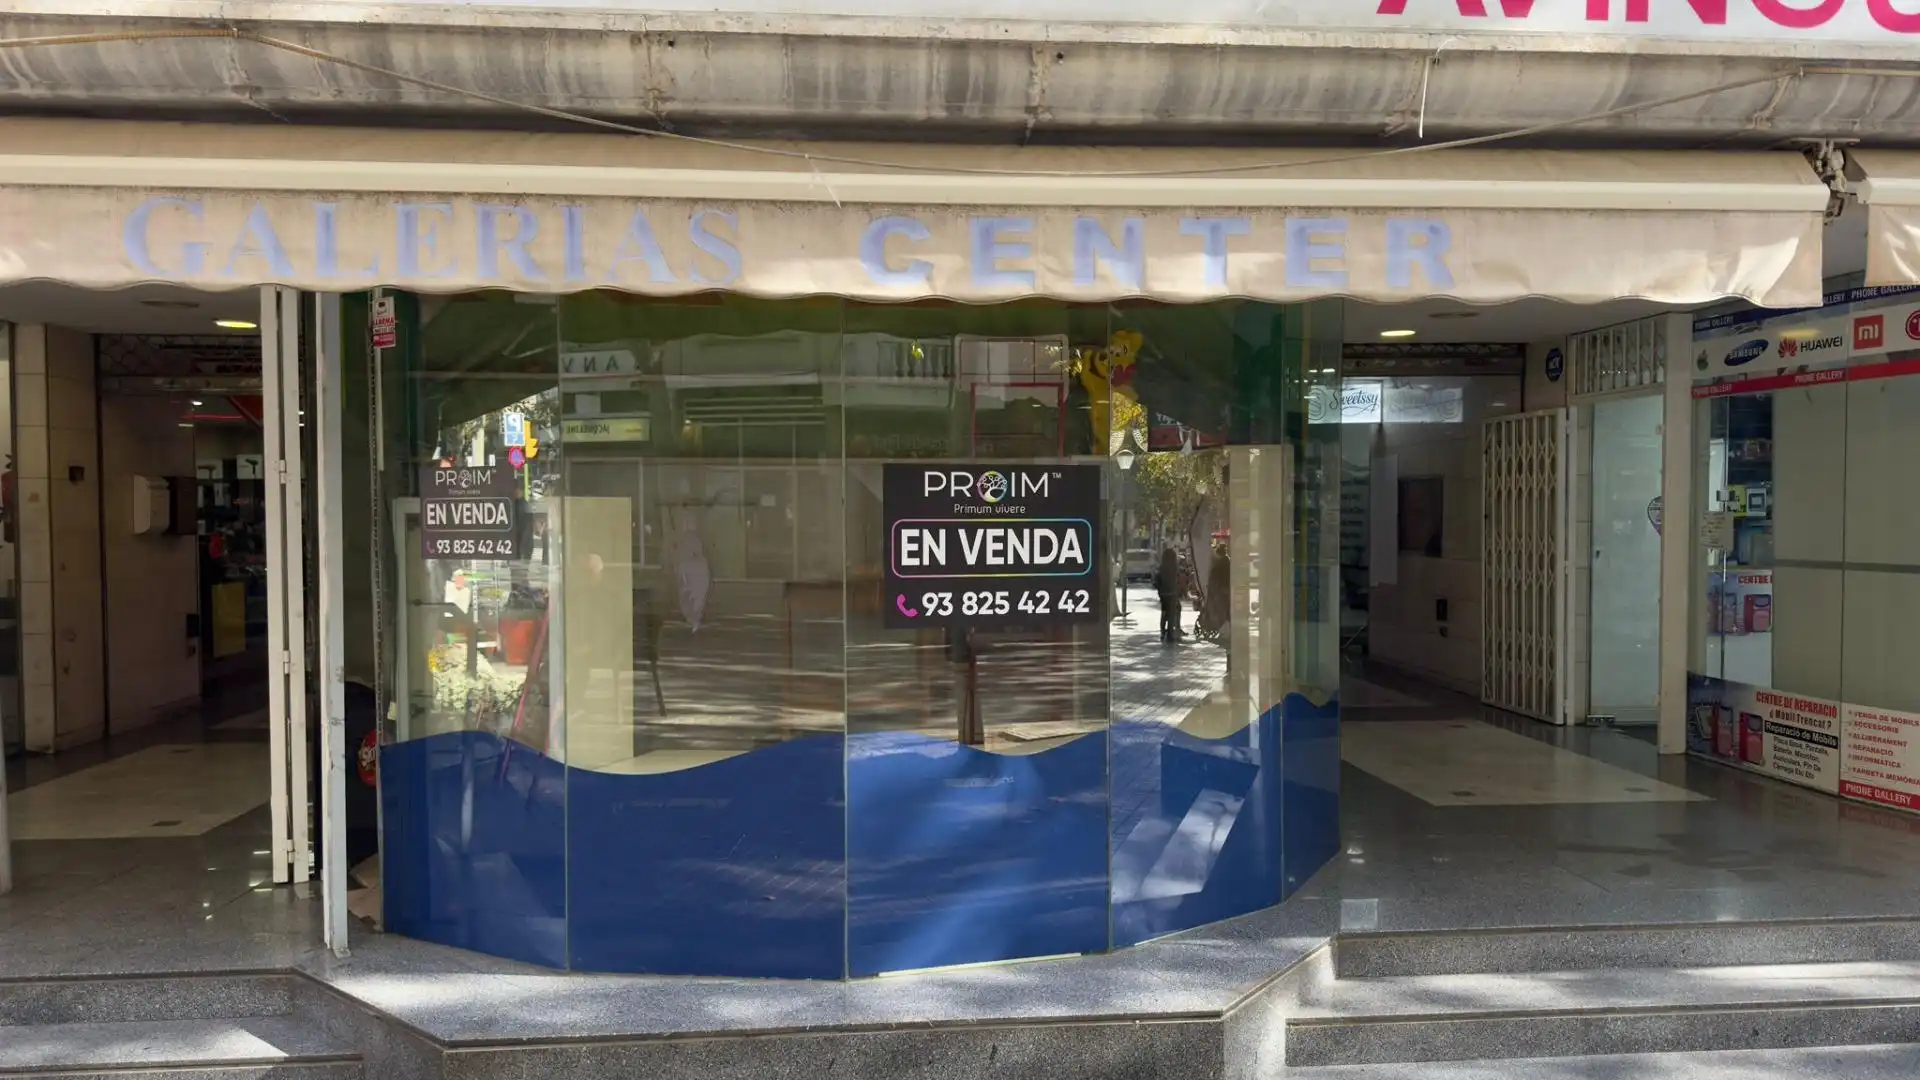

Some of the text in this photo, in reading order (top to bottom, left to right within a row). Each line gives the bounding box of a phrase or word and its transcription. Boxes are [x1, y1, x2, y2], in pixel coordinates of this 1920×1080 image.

[122, 195, 1456, 291] GALERIAS CENTER
[1850, 288, 1877, 299] PHONE
[1800, 337, 1843, 353] HUAWEI
[1816, 370, 1844, 381] GALLERY
[1329, 389, 1379, 413] Sweetssy
[924, 470, 1048, 502] PROIM
[426, 502, 508, 525] EN VENDA
[954, 503, 1026, 514] Primum vivere
[436, 540, 512, 554] 93 825 42 42
[901, 528, 1084, 566] EN VENDA
[922, 589, 1090, 616] 93 825 42 42
[1756, 691, 1783, 706] CENTRE
[1845, 783, 1911, 805] PHONE GALLERY
